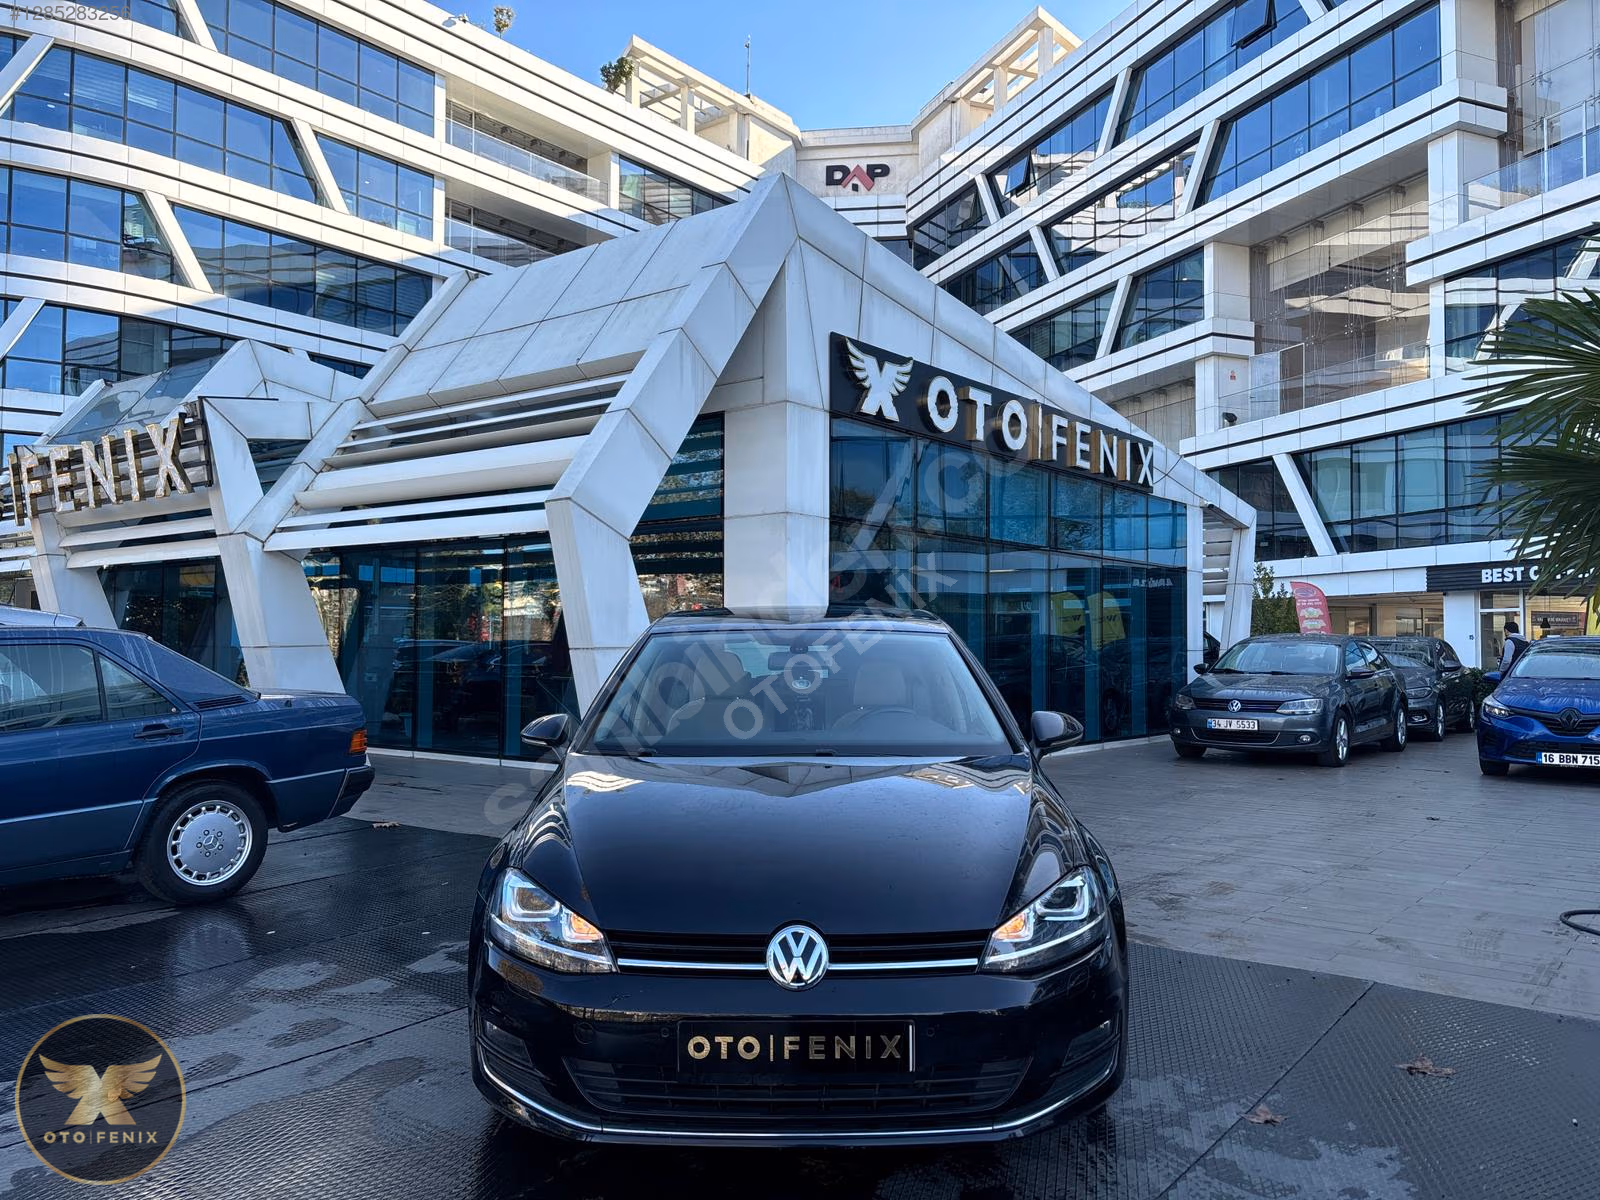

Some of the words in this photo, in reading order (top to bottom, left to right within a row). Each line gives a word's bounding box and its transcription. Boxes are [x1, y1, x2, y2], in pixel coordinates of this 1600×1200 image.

[1481, 566, 1524, 583] BEST
[1211, 719, 1222, 729] 34
[1235, 719, 1256, 730] 5533
[1543, 753, 1555, 763] 16
[1558, 754, 1579, 765] BBN
